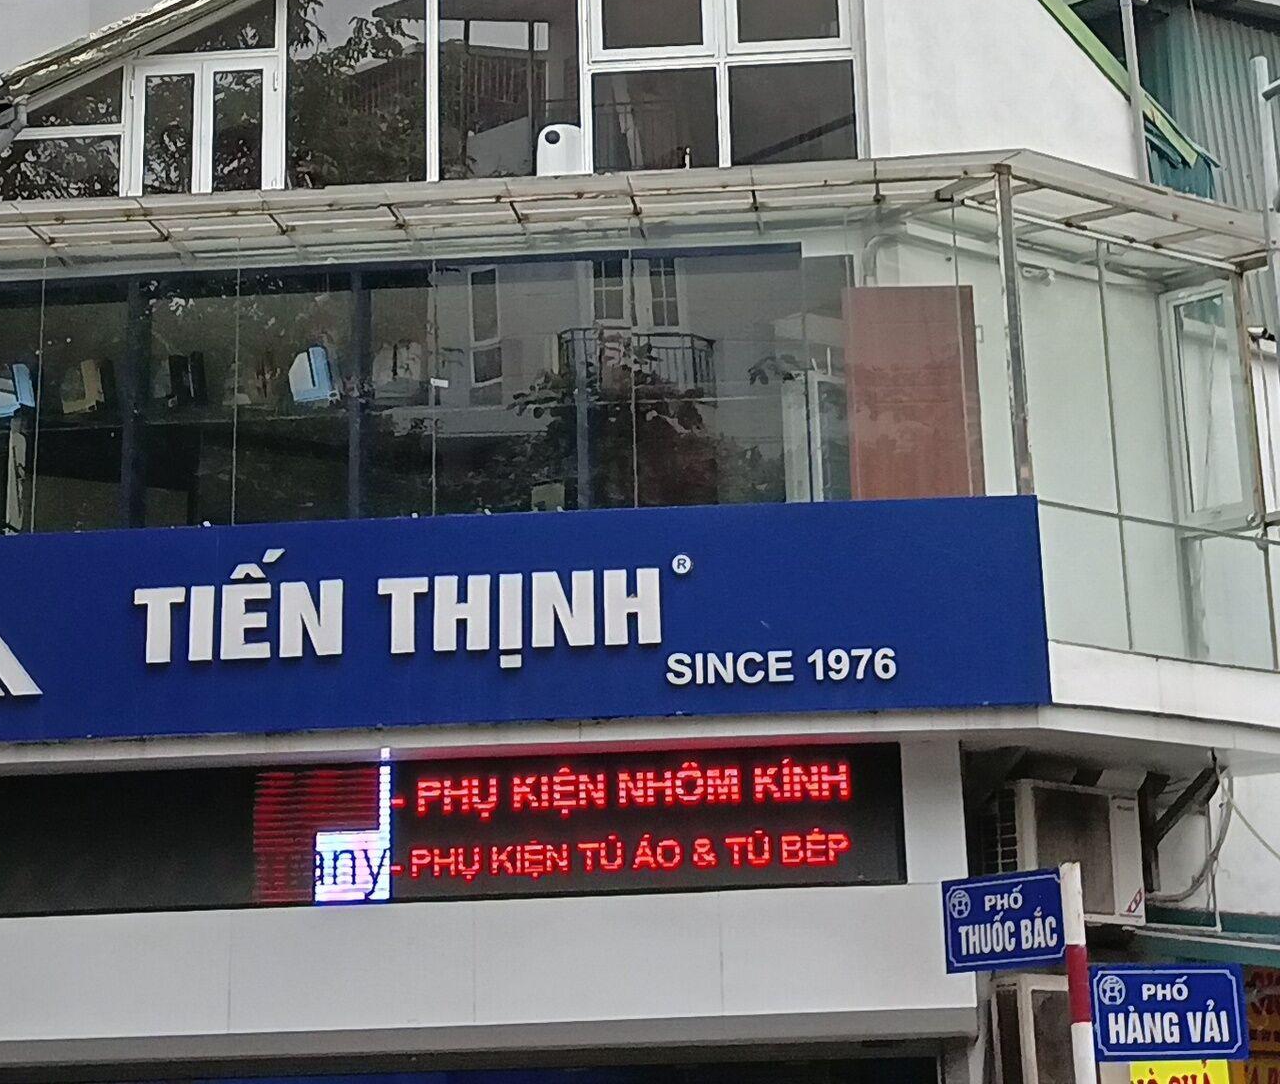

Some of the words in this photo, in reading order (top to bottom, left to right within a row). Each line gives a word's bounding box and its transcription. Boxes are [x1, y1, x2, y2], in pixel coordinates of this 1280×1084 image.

[134, 548, 343, 664] TIẾN
[377, 568, 662, 668] THỊNH
[666, 650, 795, 685] SINCE
[807, 647, 897, 681] 1976
[417, 776, 498, 819] PHỤ
[512, 766, 606, 815] KIỆN
[754, 758, 850, 800] KÍNH
[411, 846, 480, 880] PHỤ
[491, 839, 568, 878] KIỆN
[632, 833, 681, 869] ÁO
[984, 884, 1023, 912] PHỐ
[958, 911, 1016, 956] THUỐC
[1020, 906, 1058, 950] BẮC
[1141, 975, 1189, 1001] PHỐ
[1108, 1005, 1180, 1044] HÀNG
[1186, 998, 1230, 1043] VẢI
